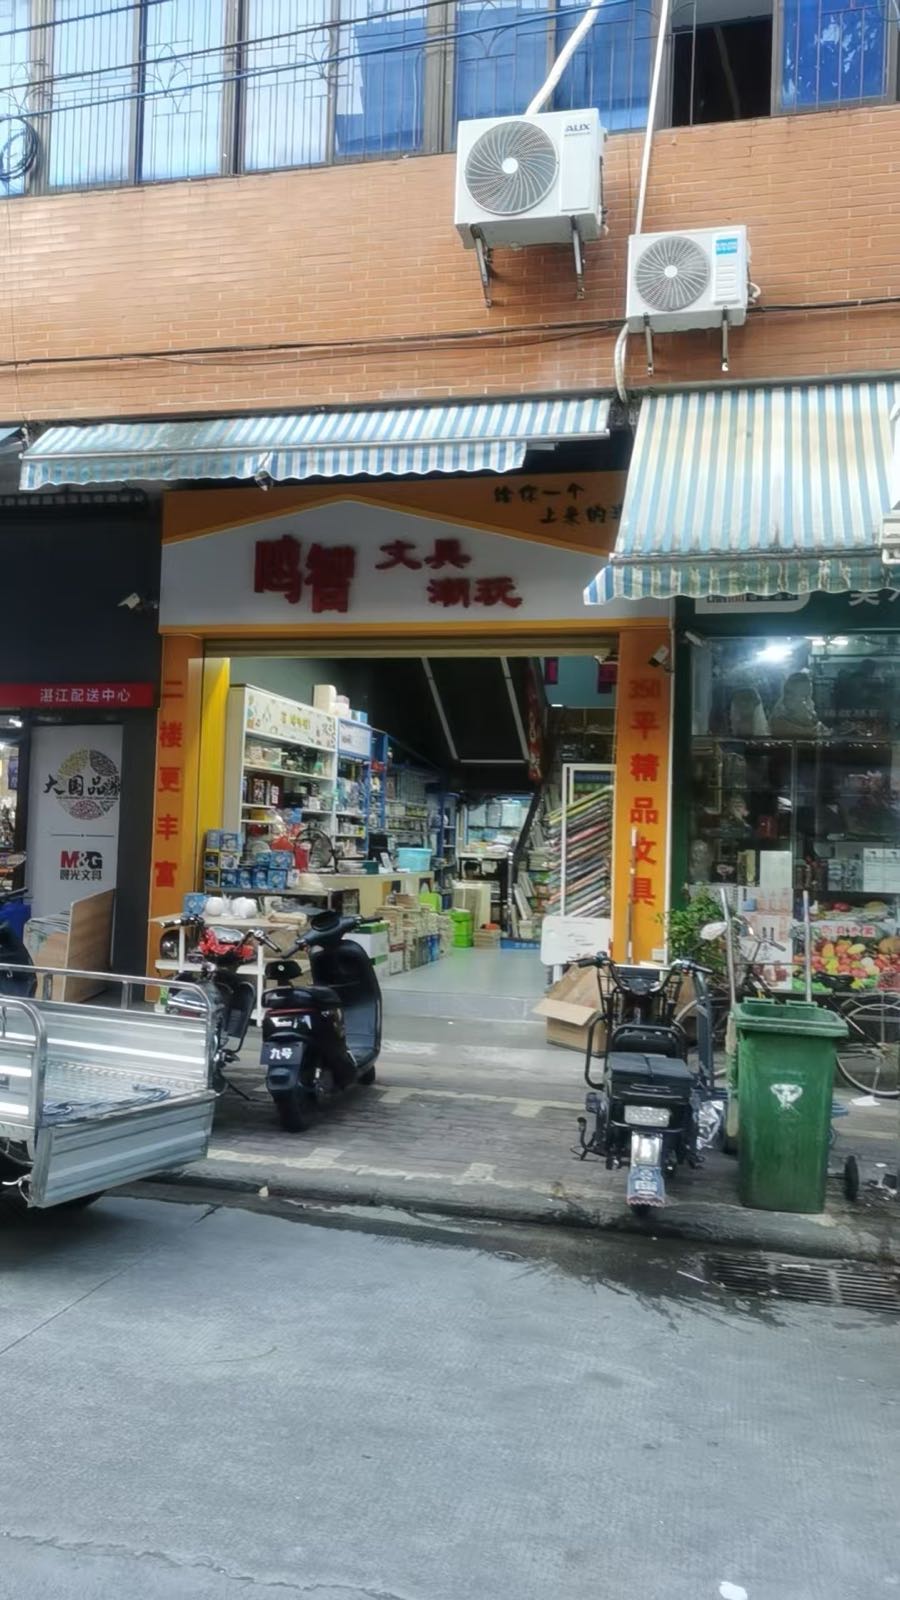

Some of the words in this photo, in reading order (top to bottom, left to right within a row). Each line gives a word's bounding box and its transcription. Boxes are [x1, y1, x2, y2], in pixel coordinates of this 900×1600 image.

[565, 123, 591, 131] AUX
[375, 539, 472, 570] 文具
[427, 576, 523, 609] 潮玩
[40, 688, 131, 702] 湛江配送中心
[155, 680, 184, 888] 二楼更丰富
[61, 851, 103, 869] M&G
[270, 1047, 293, 1060] 九号
